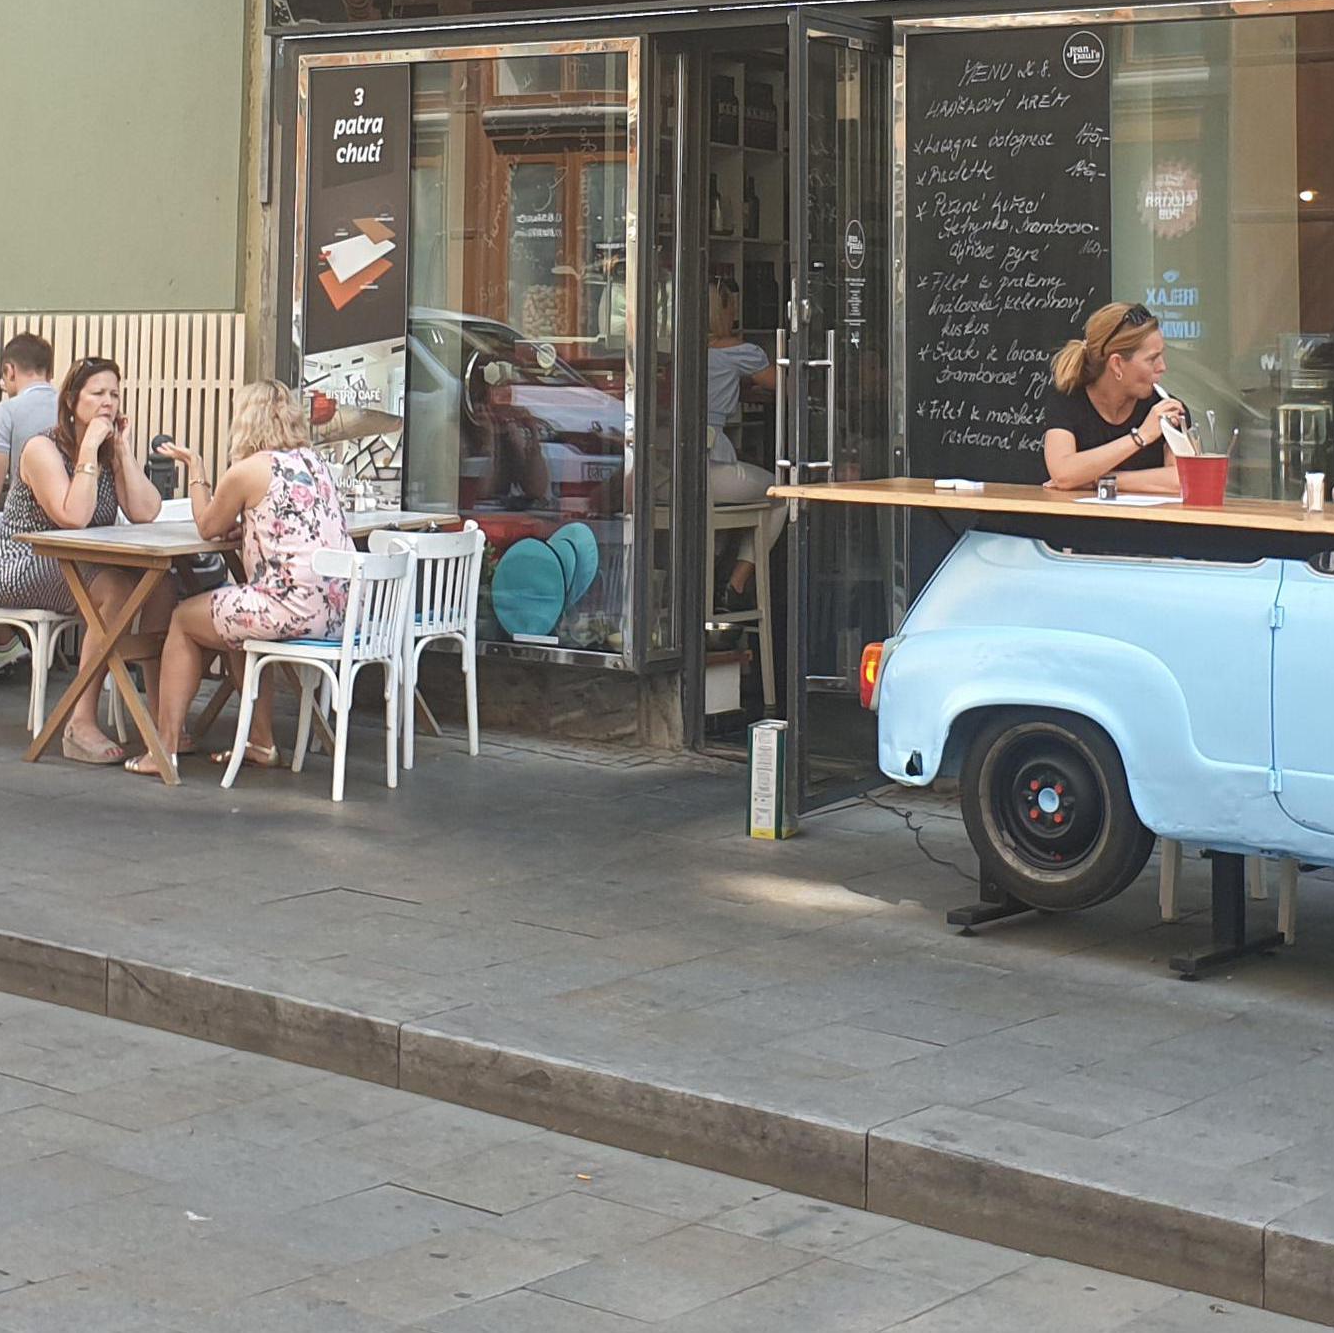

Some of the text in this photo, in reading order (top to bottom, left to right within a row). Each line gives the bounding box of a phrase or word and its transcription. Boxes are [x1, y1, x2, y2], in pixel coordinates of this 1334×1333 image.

[958, 59, 1013, 87] MENU
[353, 88, 365, 107] 3
[333, 116, 384, 140] patra
[336, 139, 384, 164] chutí
